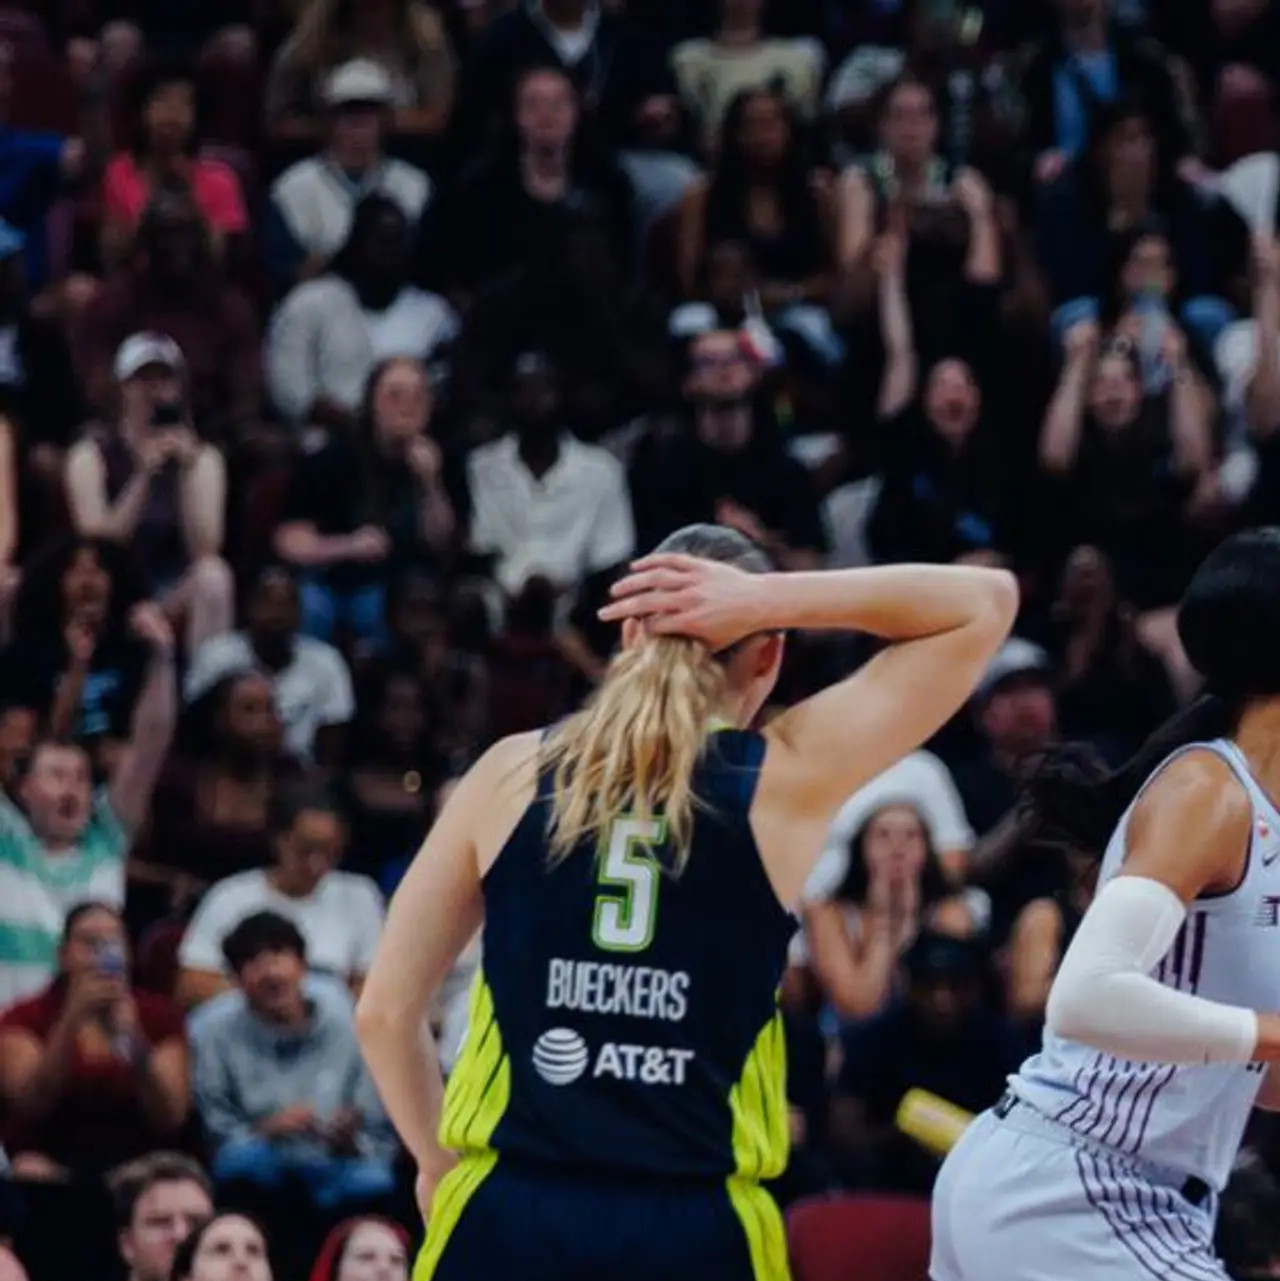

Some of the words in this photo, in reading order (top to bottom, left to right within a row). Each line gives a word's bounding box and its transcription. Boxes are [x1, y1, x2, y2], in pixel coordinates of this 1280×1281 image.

[592, 813, 668, 952] 5
[546, 958, 690, 1020] BUECKERS
[594, 1043, 694, 1085] AT&T
